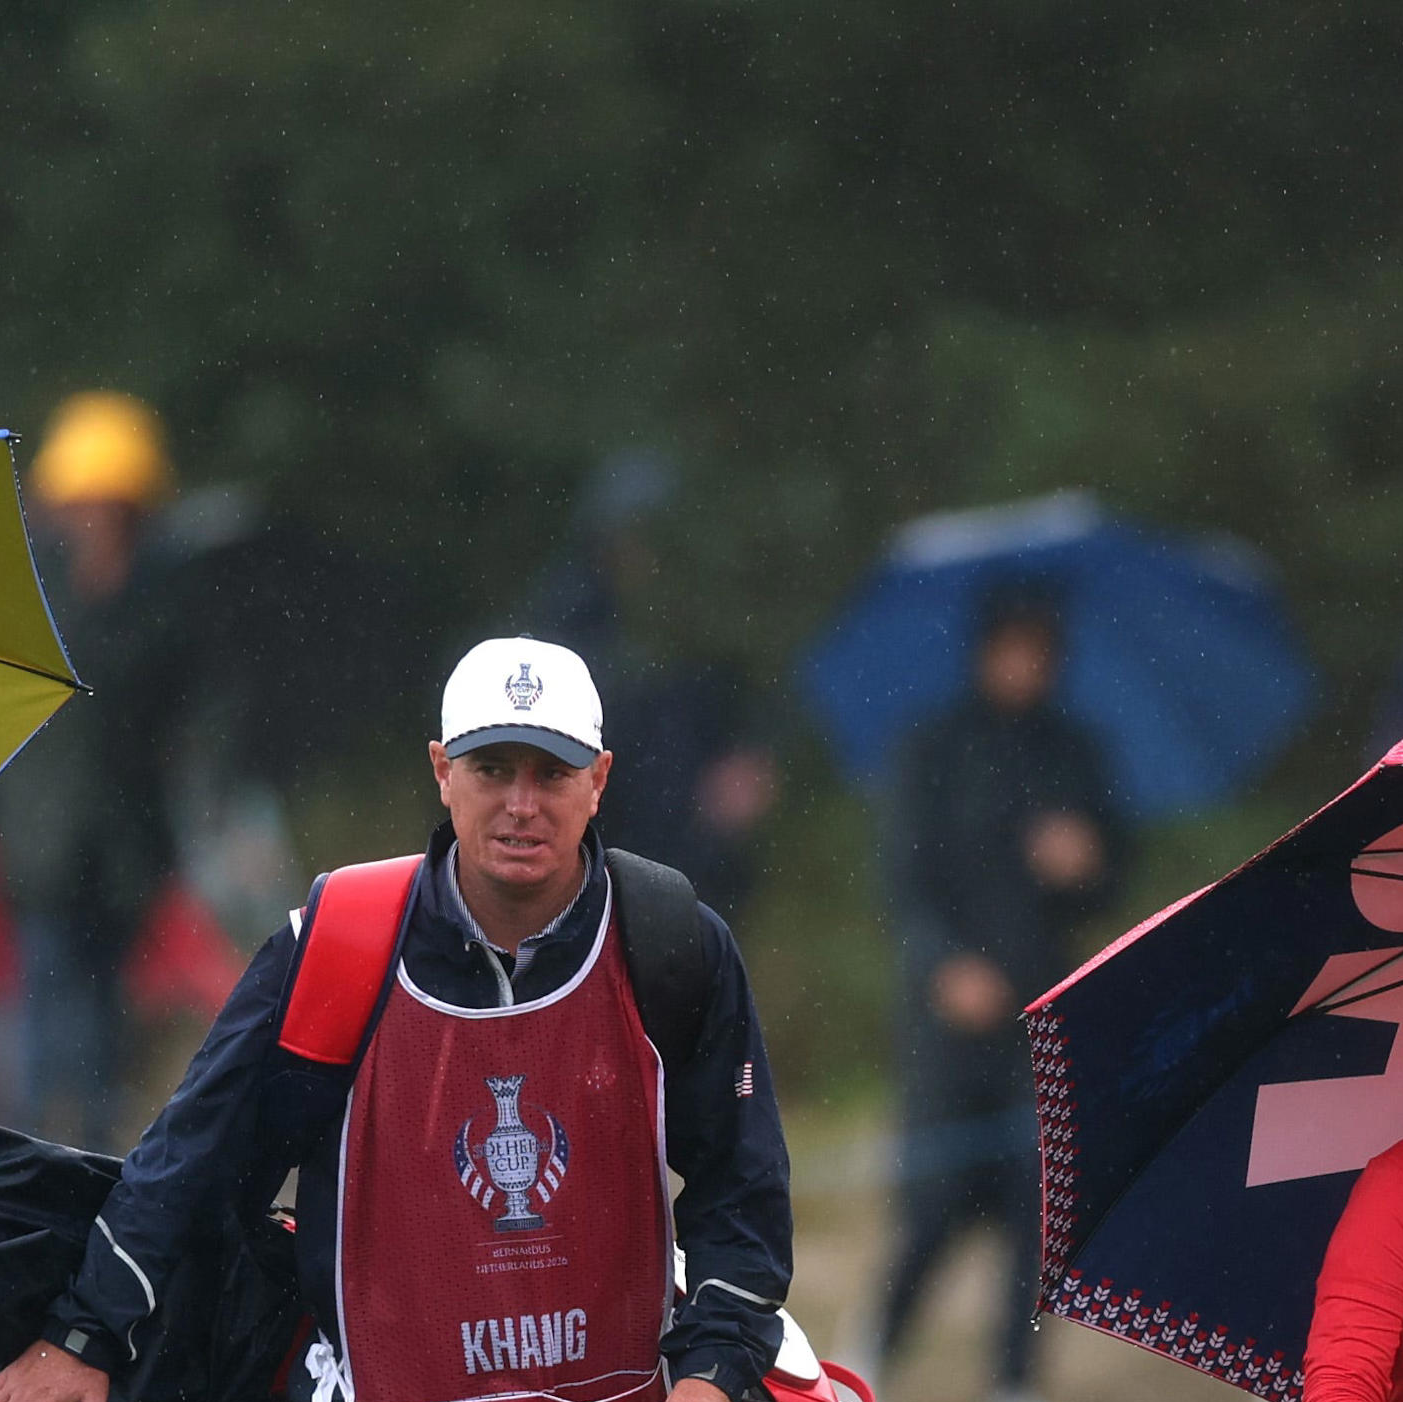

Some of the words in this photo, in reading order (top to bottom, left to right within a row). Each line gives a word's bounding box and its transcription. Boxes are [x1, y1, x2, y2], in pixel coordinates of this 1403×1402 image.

[495, 1156, 529, 1172] CUP
[492, 1243, 552, 1258] BERNARDUS
[460, 1308, 588, 1375] KHANG
